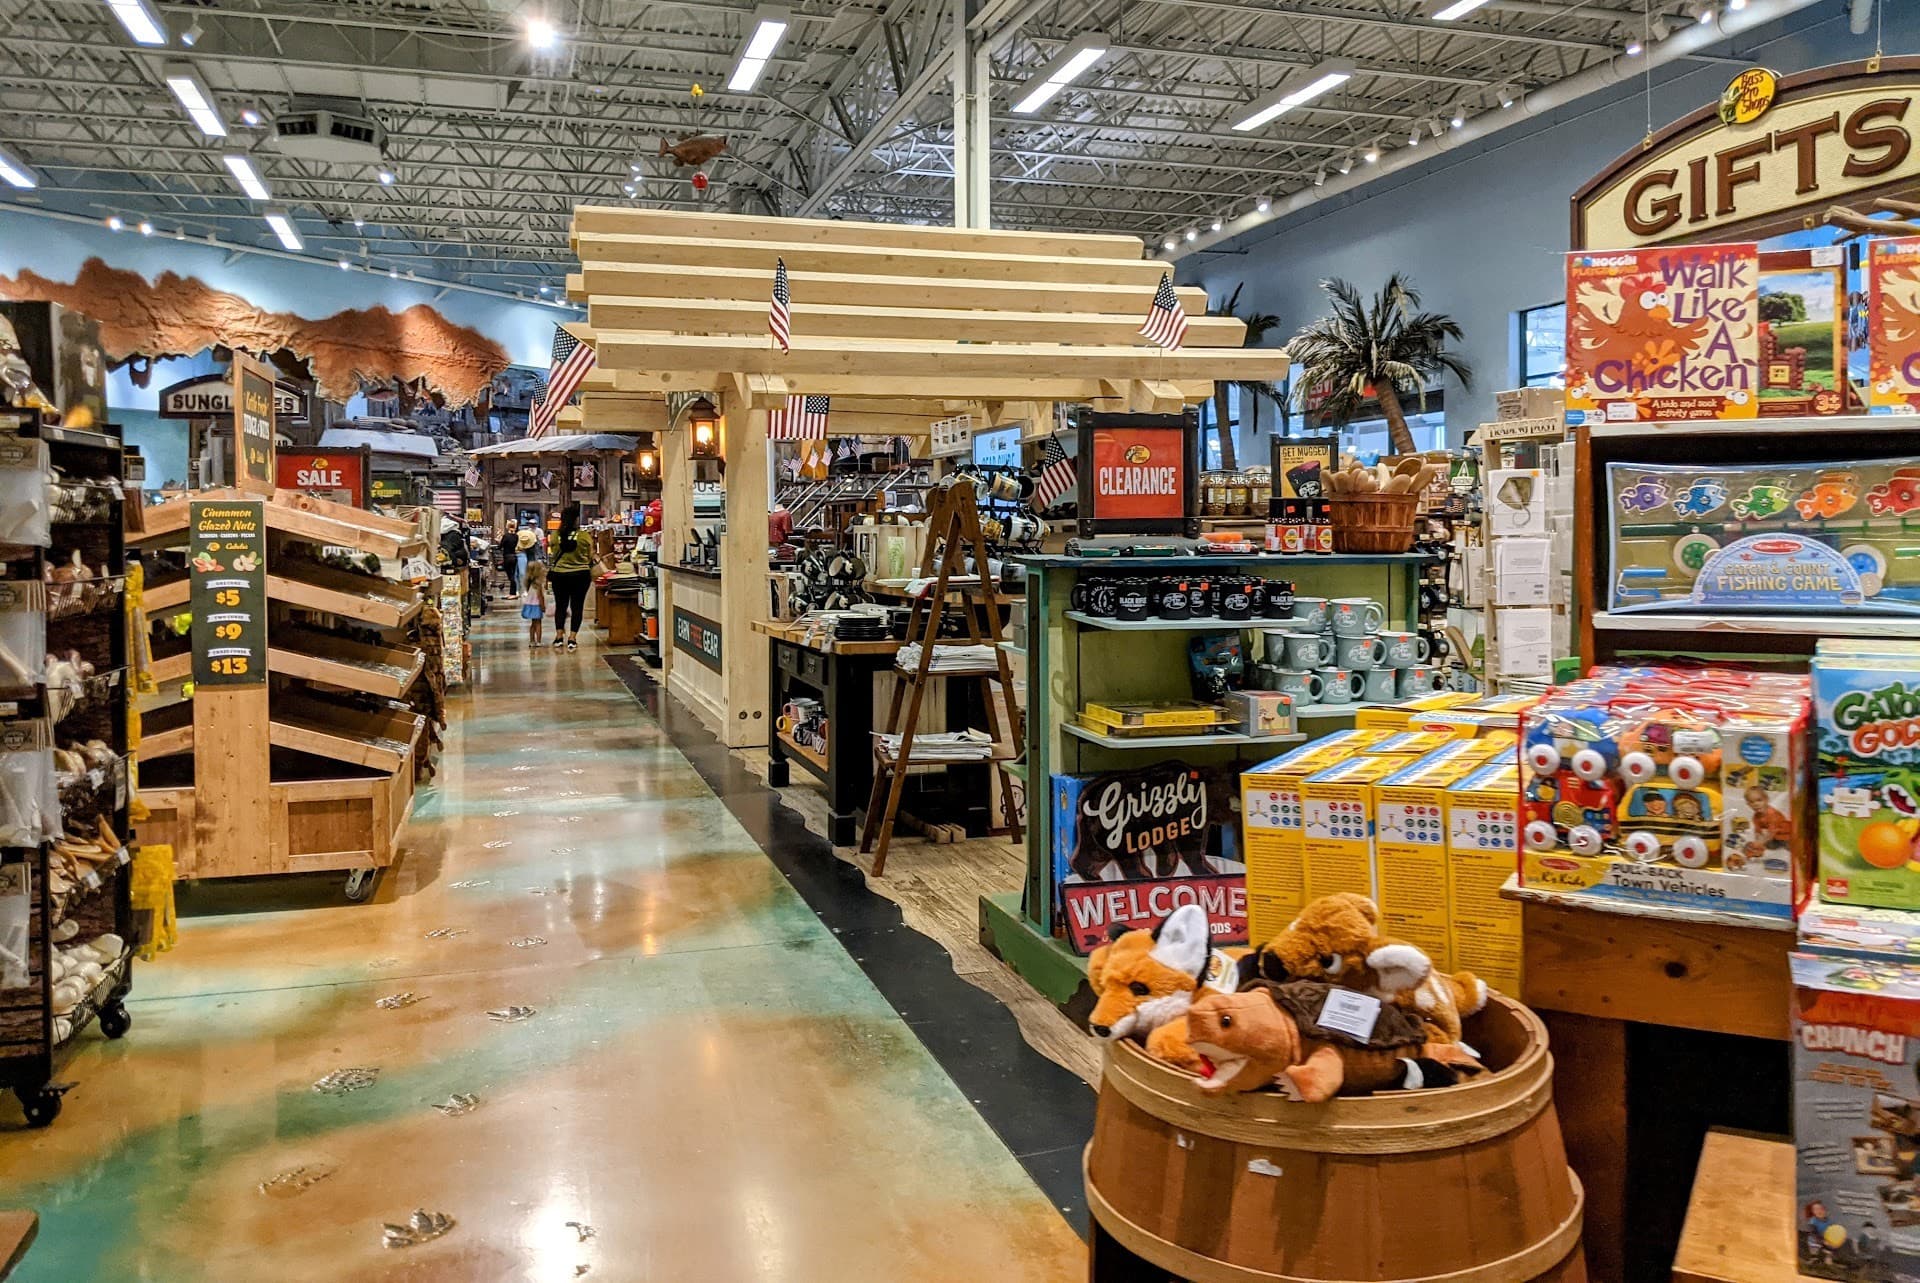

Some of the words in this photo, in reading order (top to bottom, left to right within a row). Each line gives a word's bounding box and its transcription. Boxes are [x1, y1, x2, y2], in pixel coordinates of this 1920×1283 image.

[1740, 70, 1765, 89] Bass
[1741, 86, 1760, 100] Pro
[1741, 95, 1771, 115] Shops
[1623, 97, 1912, 236] GIFTS
[1659, 253, 1749, 289] Walk
[1672, 287, 1747, 324] Like
[1704, 321, 1738, 363] A
[1594, 355, 1749, 394] Chicken
[1282, 447, 1295, 457] GET
[1297, 446, 1328, 457] MUGGED!
[296, 470, 343, 486] SALE
[1099, 466, 1177, 495] CLEARANCE
[202, 507, 252, 519] Cinnamon
[198, 520, 231, 532] Glazed
[232, 519, 257, 531] Nuts
[1724, 563, 1766, 576] CATCH
[1769, 560, 1781, 575] &
[1785, 562, 1830, 575] COUNT
[1717, 575, 1788, 591] FISHING
[1791, 575, 1843, 591] GAME
[215, 589, 241, 607] $5
[215, 622, 242, 640] $9
[210, 657, 248, 675] $13
[1834, 680, 1920, 732] GATO
[1082, 771, 1208, 850] Grizzly
[1125, 817, 1191, 854] LODGE
[1612, 862, 1684, 880] PULL-BACK
[1612, 873, 1655, 890] Town
[1659, 878, 1726, 899] Vehicles
[1069, 884, 1248, 930] WELCOME
[1802, 1022, 1905, 1065] CRUNCH
